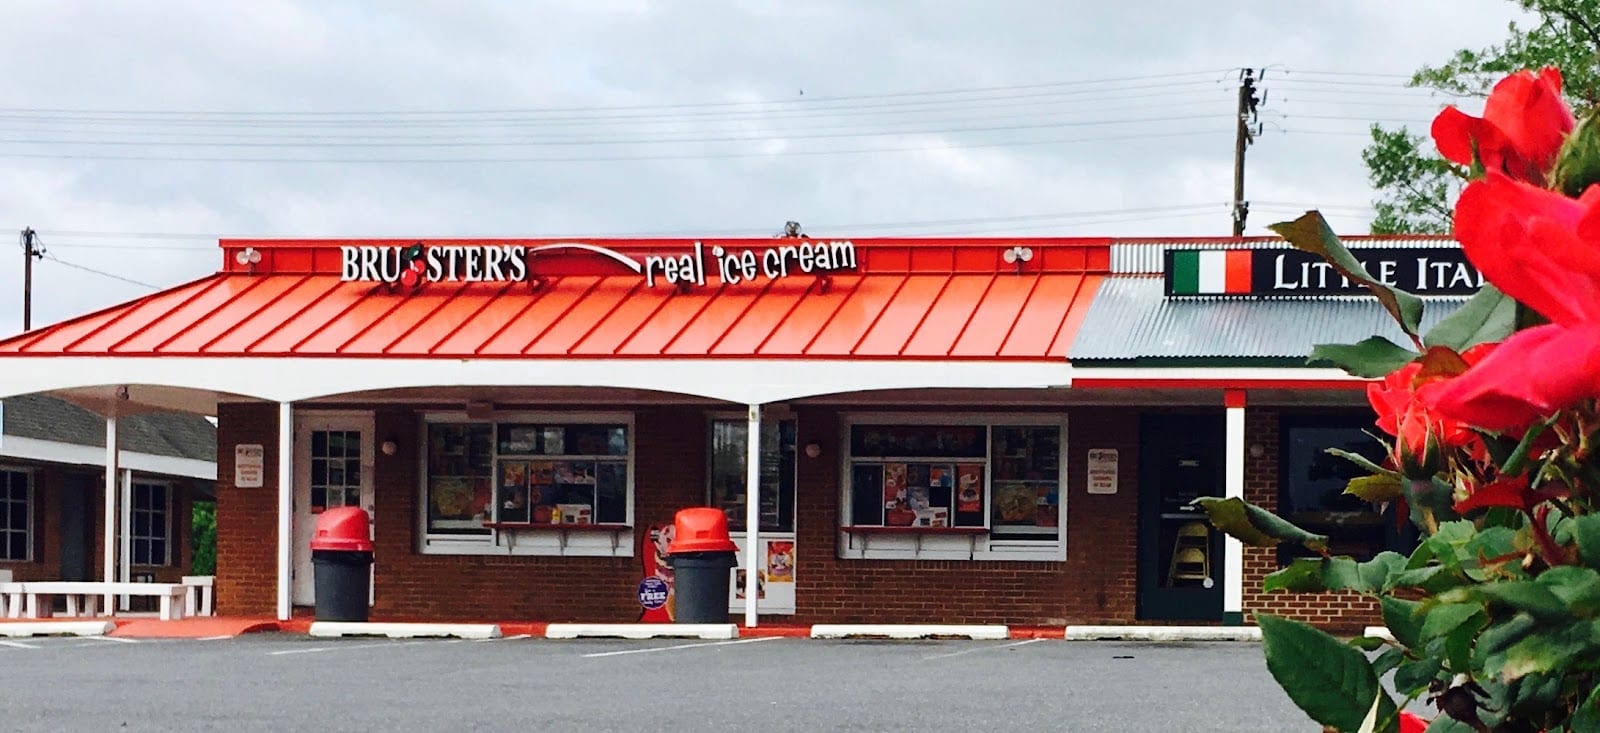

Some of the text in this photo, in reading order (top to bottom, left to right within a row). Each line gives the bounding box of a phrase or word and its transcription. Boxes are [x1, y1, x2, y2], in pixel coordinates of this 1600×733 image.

[646, 241, 857, 287] real ice cream
[1273, 253, 1397, 290] LITE
